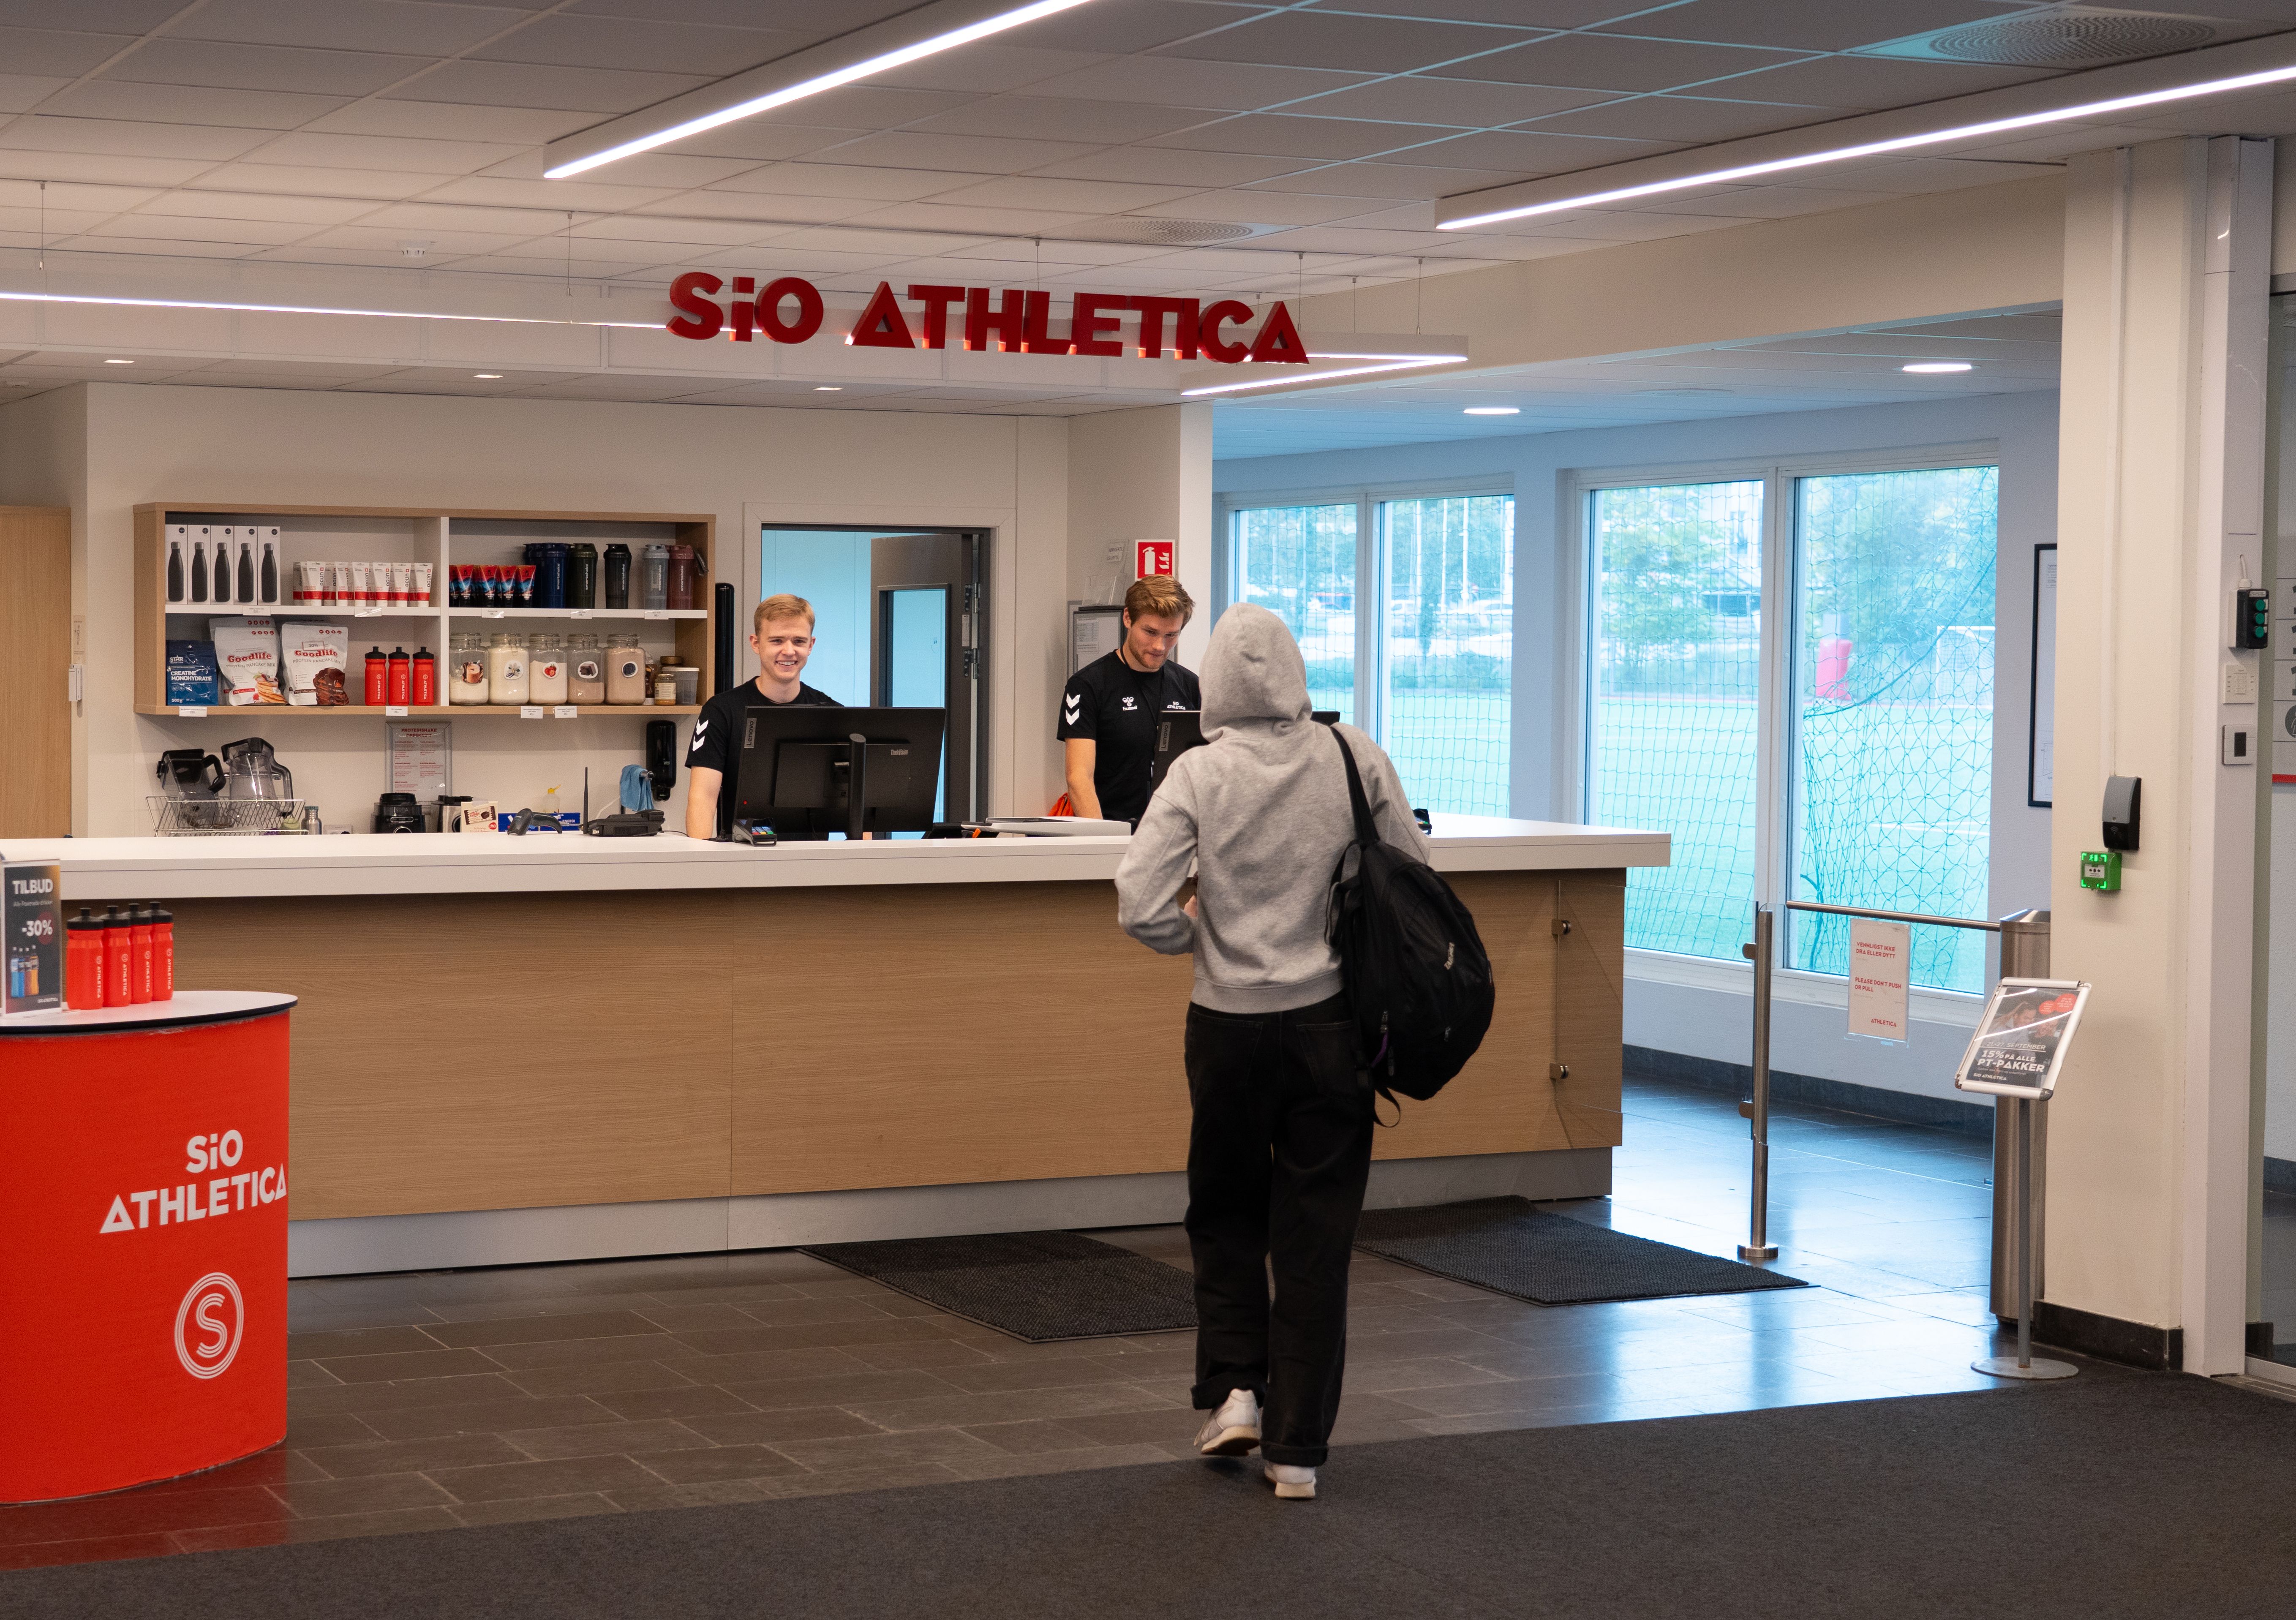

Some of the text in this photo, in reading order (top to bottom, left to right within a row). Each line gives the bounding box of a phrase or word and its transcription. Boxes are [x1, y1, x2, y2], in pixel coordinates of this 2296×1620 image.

[666, 272, 1309, 364] SiO ATHLETICA
[228, 652, 272, 663] Goodlife
[295, 649, 338, 657] Goodlife
[12, 879, 53, 894] TILBUD
[22, 919, 53, 937] -30%
[1857, 942, 1883, 950] VENNLIGST
[1871, 1018, 1897, 1027] ATHLETICA
[1981, 1050, 2005, 1059] 15%
[1977, 1059, 2045, 1073] PT-PAKKER
[186, 1129, 243, 1173] SiO
[99, 1163, 287, 1234] ATHLETICA
